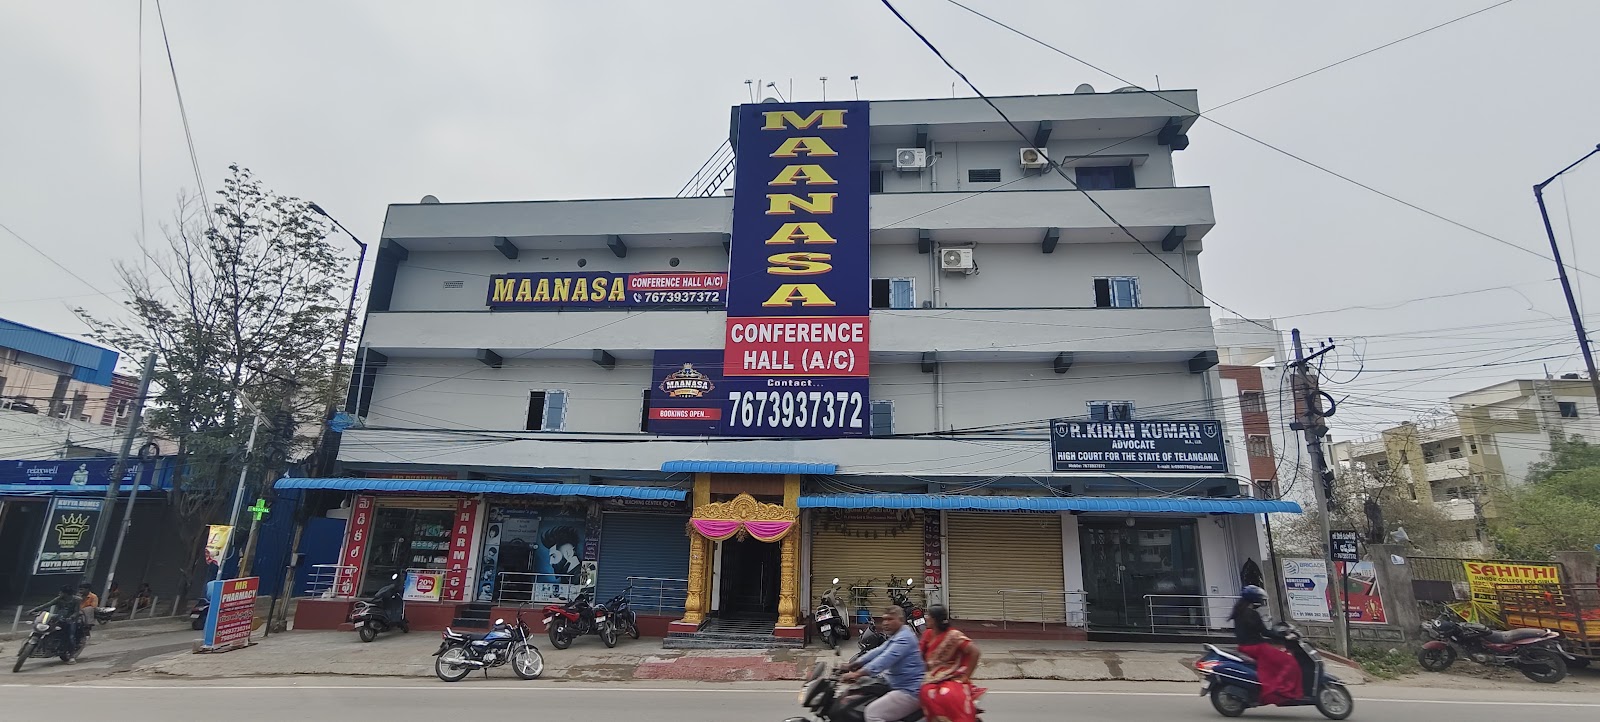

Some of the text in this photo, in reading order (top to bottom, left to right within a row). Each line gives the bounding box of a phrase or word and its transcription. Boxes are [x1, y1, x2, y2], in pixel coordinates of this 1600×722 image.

[761, 109, 848, 307] MAANASA
[631, 276, 724, 288] CONFERENCE HALL (A/C)
[492, 277, 626, 303] MAANASA
[644, 291, 720, 303] 7673937372
[731, 322, 864, 343] CONFERENCE
[743, 348, 855, 372] HALL (A/C)
[666, 380, 708, 390] MAANASA
[767, 379, 824, 387] Contact...
[660, 410, 688, 418] BOOKINGS
[729, 391, 863, 428] 7673937372
[1070, 423, 1202, 439] R.KIRAN KUMAR
[1112, 440, 1155, 449] ADVOCATE
[1057, 452, 1219, 462] HIGH COURT FOR THE STATE OF TELANGANA
[449, 500, 472, 599] PHARMACY
[1468, 563, 1556, 579] SAHITHI
[235, 581, 247, 590] MR
[222, 590, 257, 603] PHARMACY
